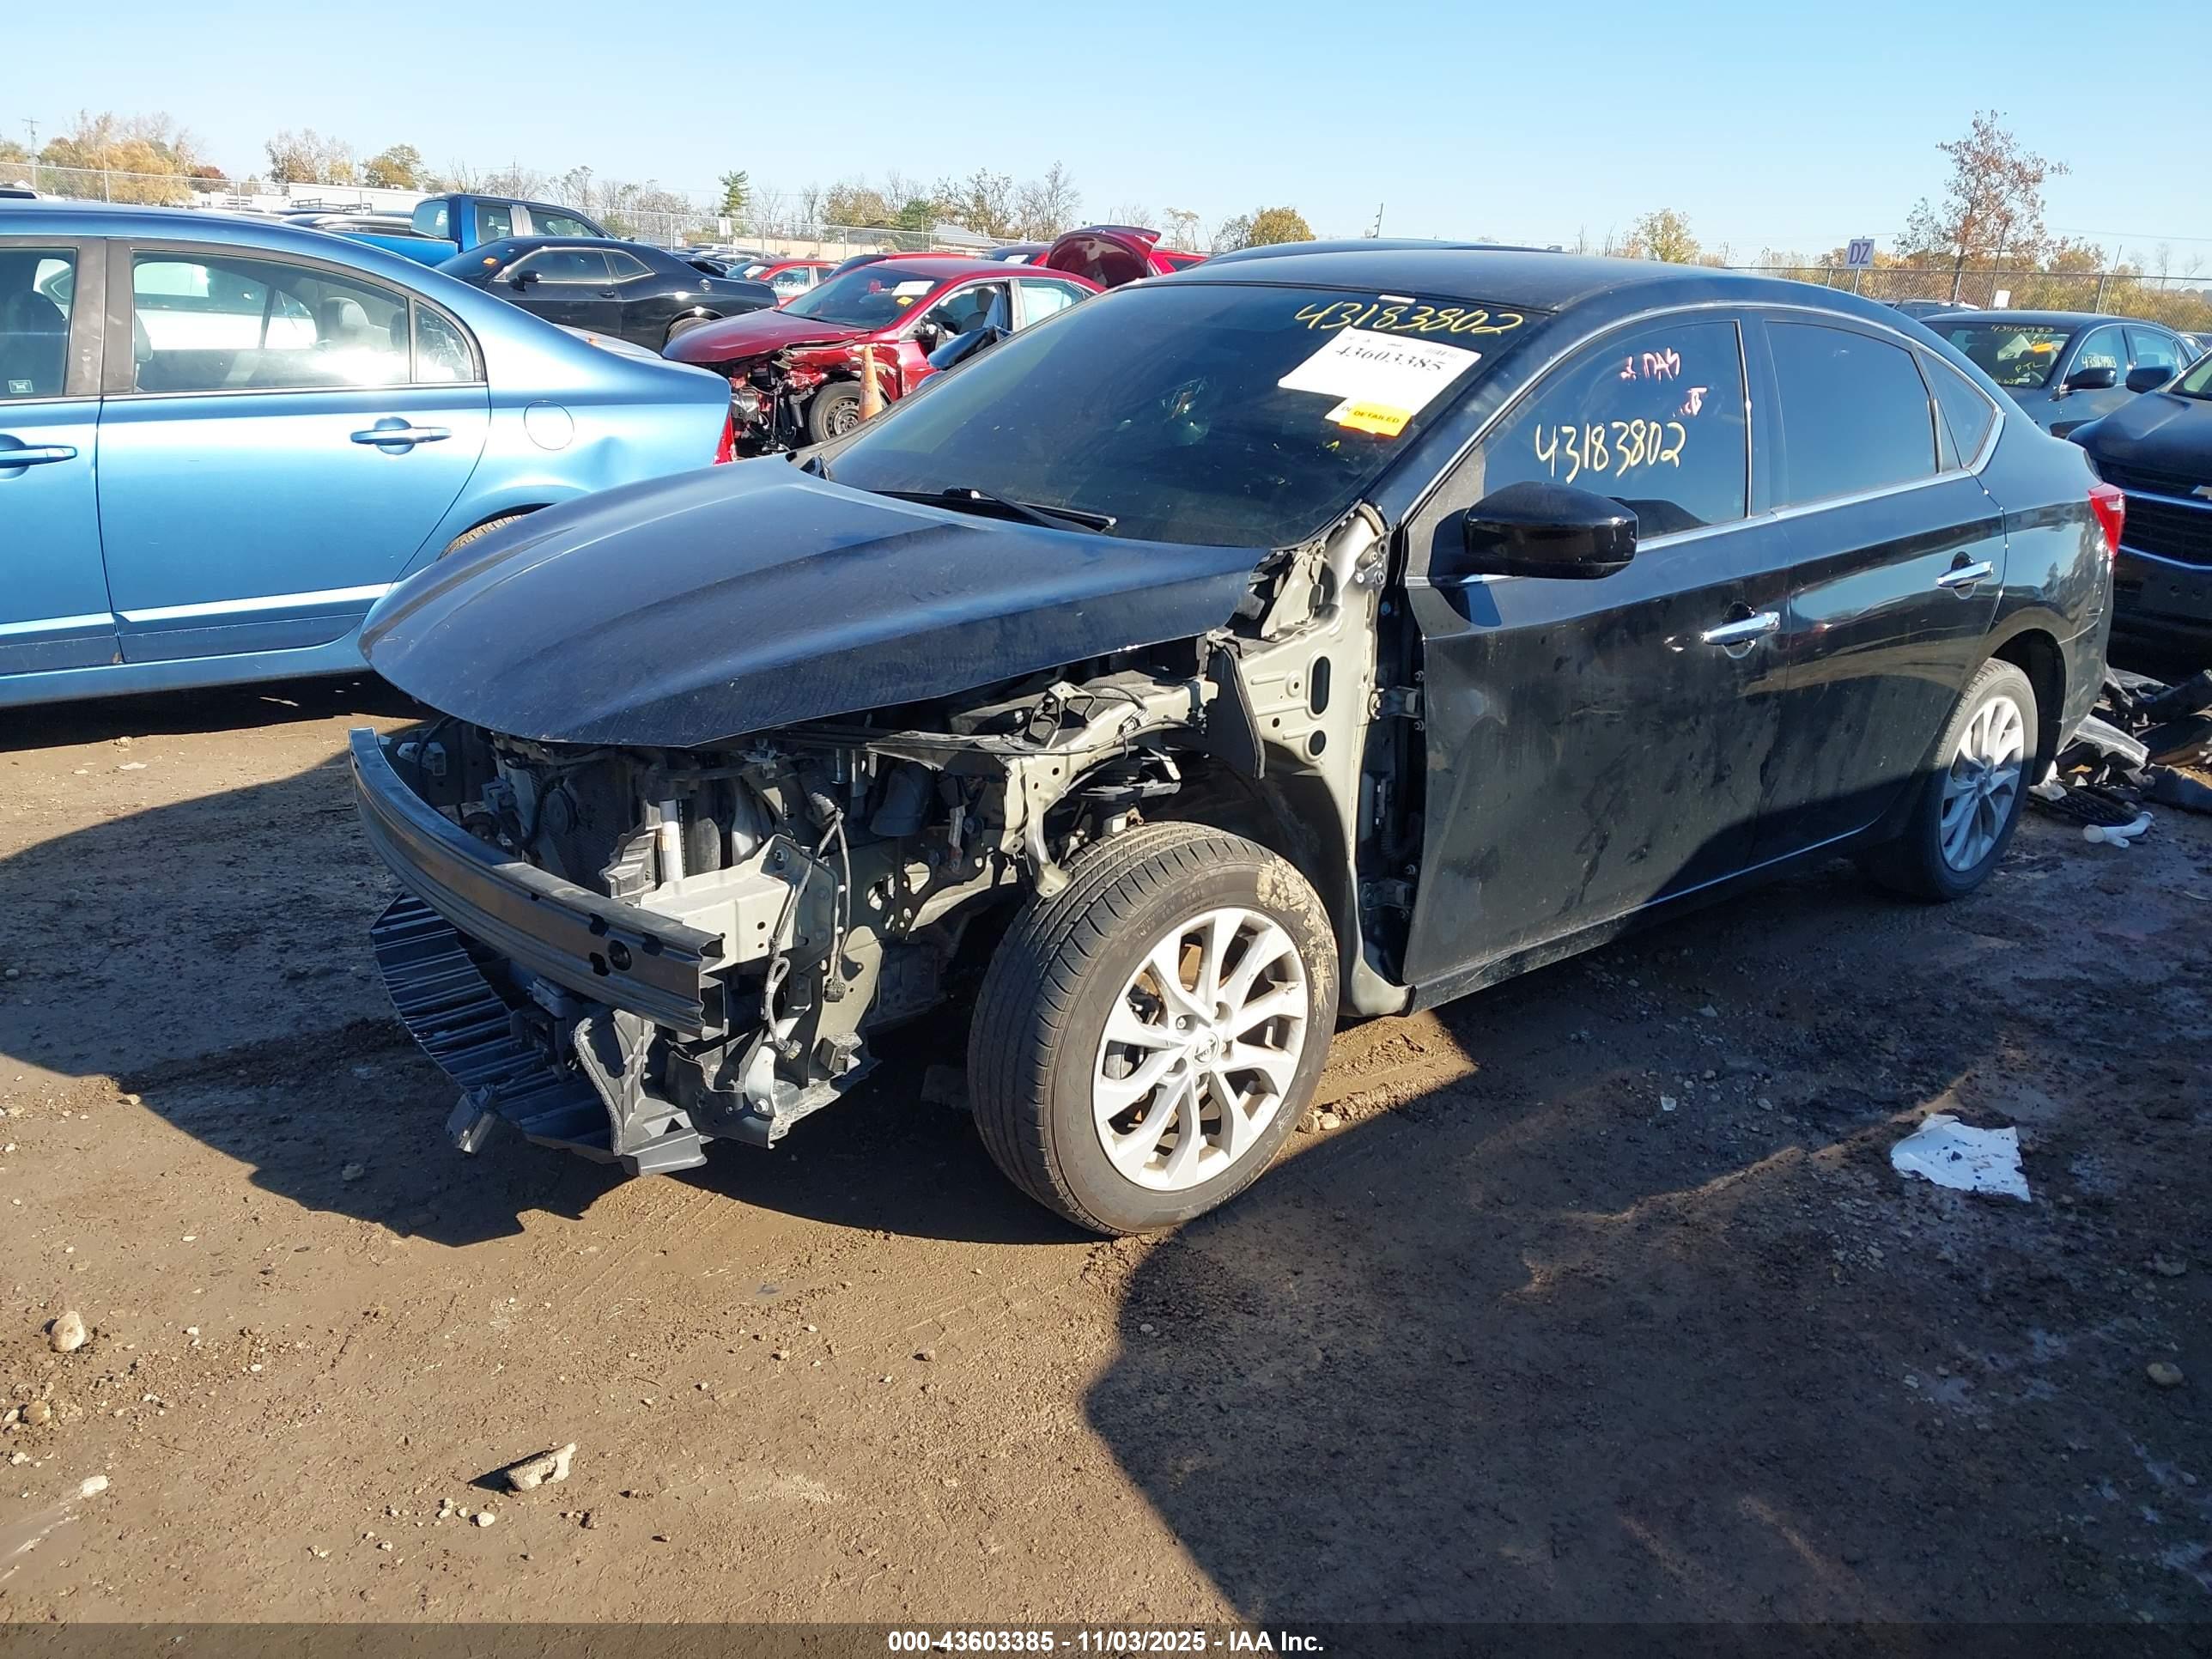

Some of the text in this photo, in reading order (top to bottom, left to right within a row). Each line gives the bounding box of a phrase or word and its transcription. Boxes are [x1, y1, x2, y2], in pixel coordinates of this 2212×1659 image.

[1294, 301, 1525, 335] 43183802
[1335, 345, 1447, 372] 43603385
[1353, 410, 1400, 424] DETAILED
[1535, 419, 1686, 484] 43183802
